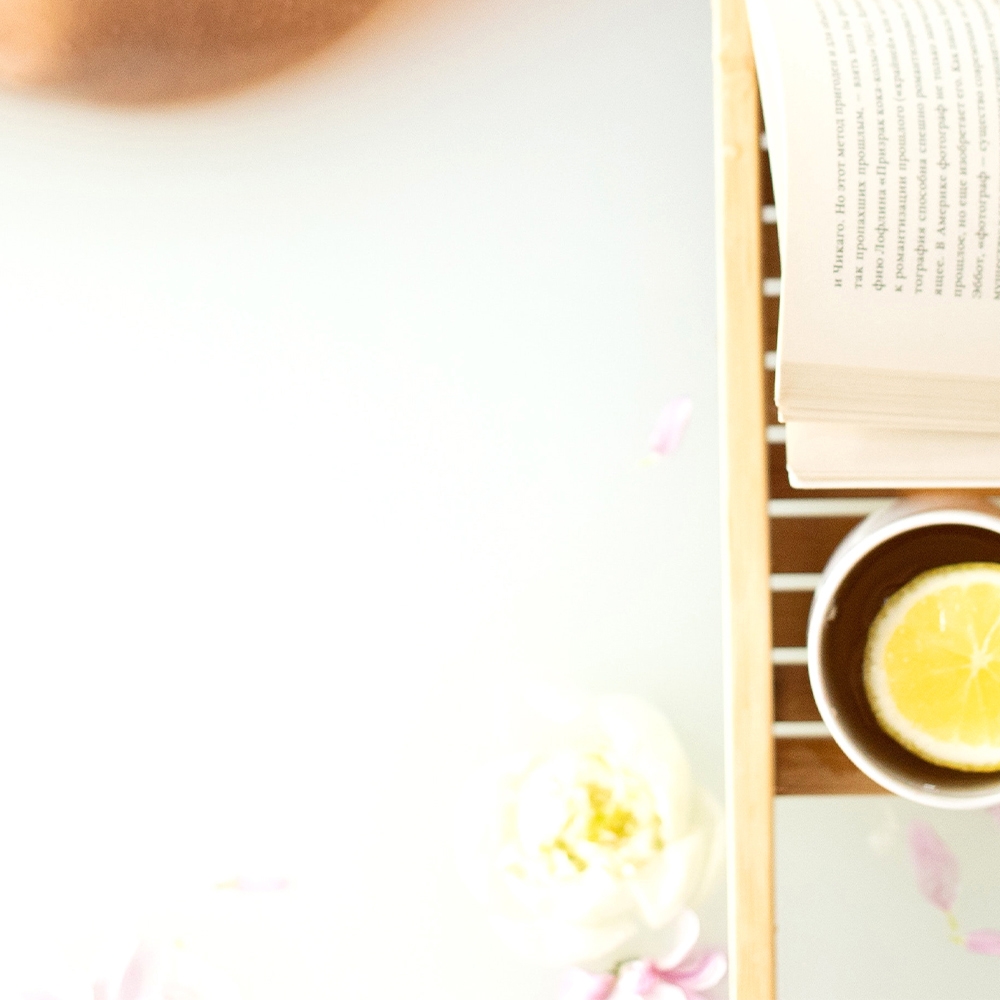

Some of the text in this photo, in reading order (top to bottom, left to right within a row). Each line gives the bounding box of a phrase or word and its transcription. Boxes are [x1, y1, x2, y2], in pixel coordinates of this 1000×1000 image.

[836, 118, 845, 158] метод
[876, 118, 889, 186] «Призрак
[897, 104, 909, 171] прошлого
[838, 161, 846, 192] этот
[835, 194, 845, 215] Но
[856, 180, 867, 261] пропахших
[875, 188, 889, 255] Лофлина
[896, 176, 907, 280] романтизации
[855, 266, 863, 290] так
[872, 257, 886, 292] фию
